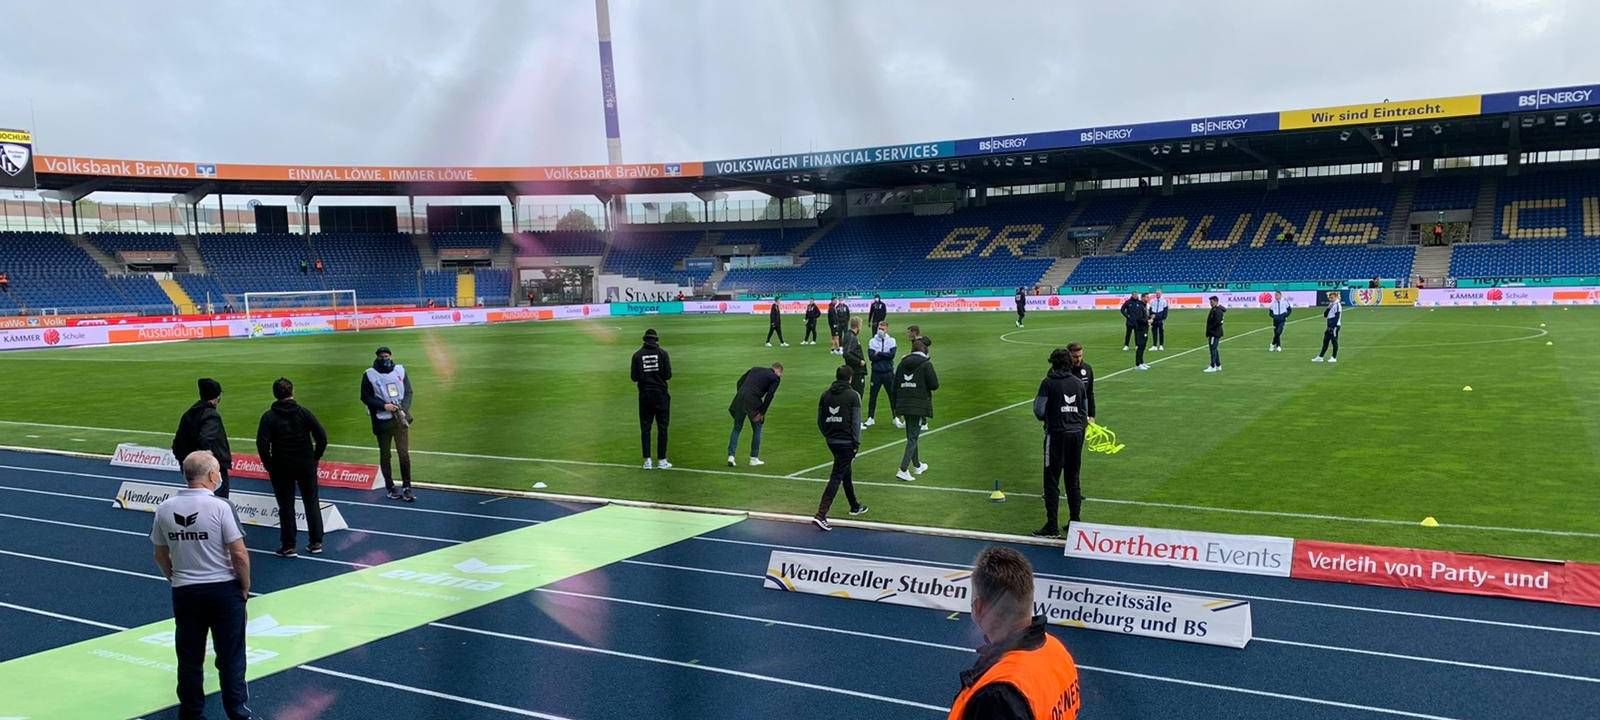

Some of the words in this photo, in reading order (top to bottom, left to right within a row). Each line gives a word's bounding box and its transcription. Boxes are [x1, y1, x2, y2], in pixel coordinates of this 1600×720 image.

[1311, 111, 1335, 123] Wir
[1338, 108, 1368, 121] sind
[1373, 103, 1445, 119] Eintracht.
[44, 157, 131, 177] Volksbank
[136, 161, 189, 177] BraWo
[715, 156, 798, 174] VOLKSWAGEN
[802, 149, 872, 168] FINANCIAL
[875, 144, 939, 162] SERVICES
[288, 168, 341, 181] EINMAL
[344, 167, 385, 181] LÖWE.
[388, 169, 435, 181] IMMER
[544, 168, 612, 181] Volksbank
[616, 164, 659, 178] BraWo
[115, 448, 161, 466] Northern
[340, 470, 370, 483] Firmen
[123, 489, 170, 504] Wendezell
[168, 530, 209, 541] erima
[1074, 529, 1199, 562] Northern
[1205, 541, 1281, 569] Events
[1308, 551, 1377, 574] Verleih
[1384, 561, 1422, 578] von
[1431, 561, 1496, 588] Party-
[1504, 571, 1548, 589] und
[780, 562, 893, 590] Wendezeller
[897, 575, 967, 599] Stuben
[1048, 584, 1172, 613] Hochzeitssäle
[1034, 601, 1135, 632] Wendeburg
[1141, 616, 1175, 634] und
[1183, 619, 1208, 637] BS
